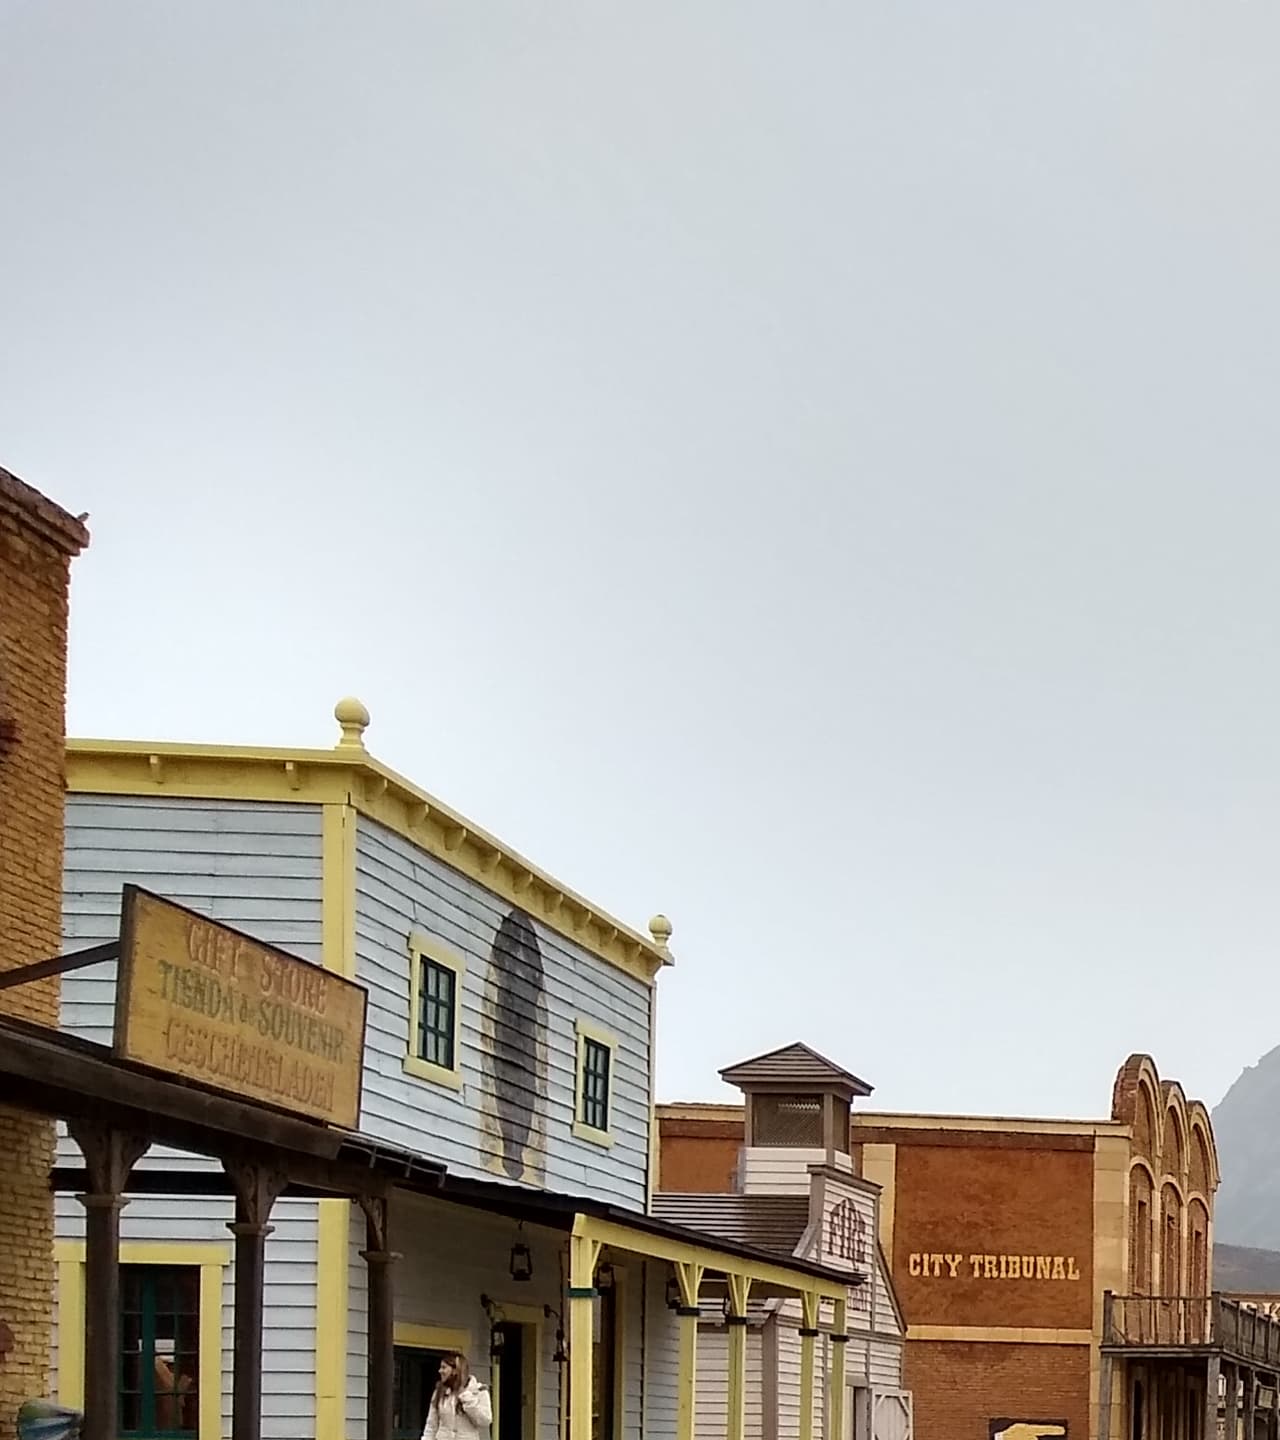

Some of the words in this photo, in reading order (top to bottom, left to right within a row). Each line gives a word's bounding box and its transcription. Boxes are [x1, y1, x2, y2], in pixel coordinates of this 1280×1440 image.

[186, 918, 246, 984] GIFT
[260, 953, 327, 1017] STORE
[257, 998, 345, 1065] SOUVENIR
[909, 1253, 963, 1277] CITY
[970, 1254, 1081, 1280] TRIBUNAL
